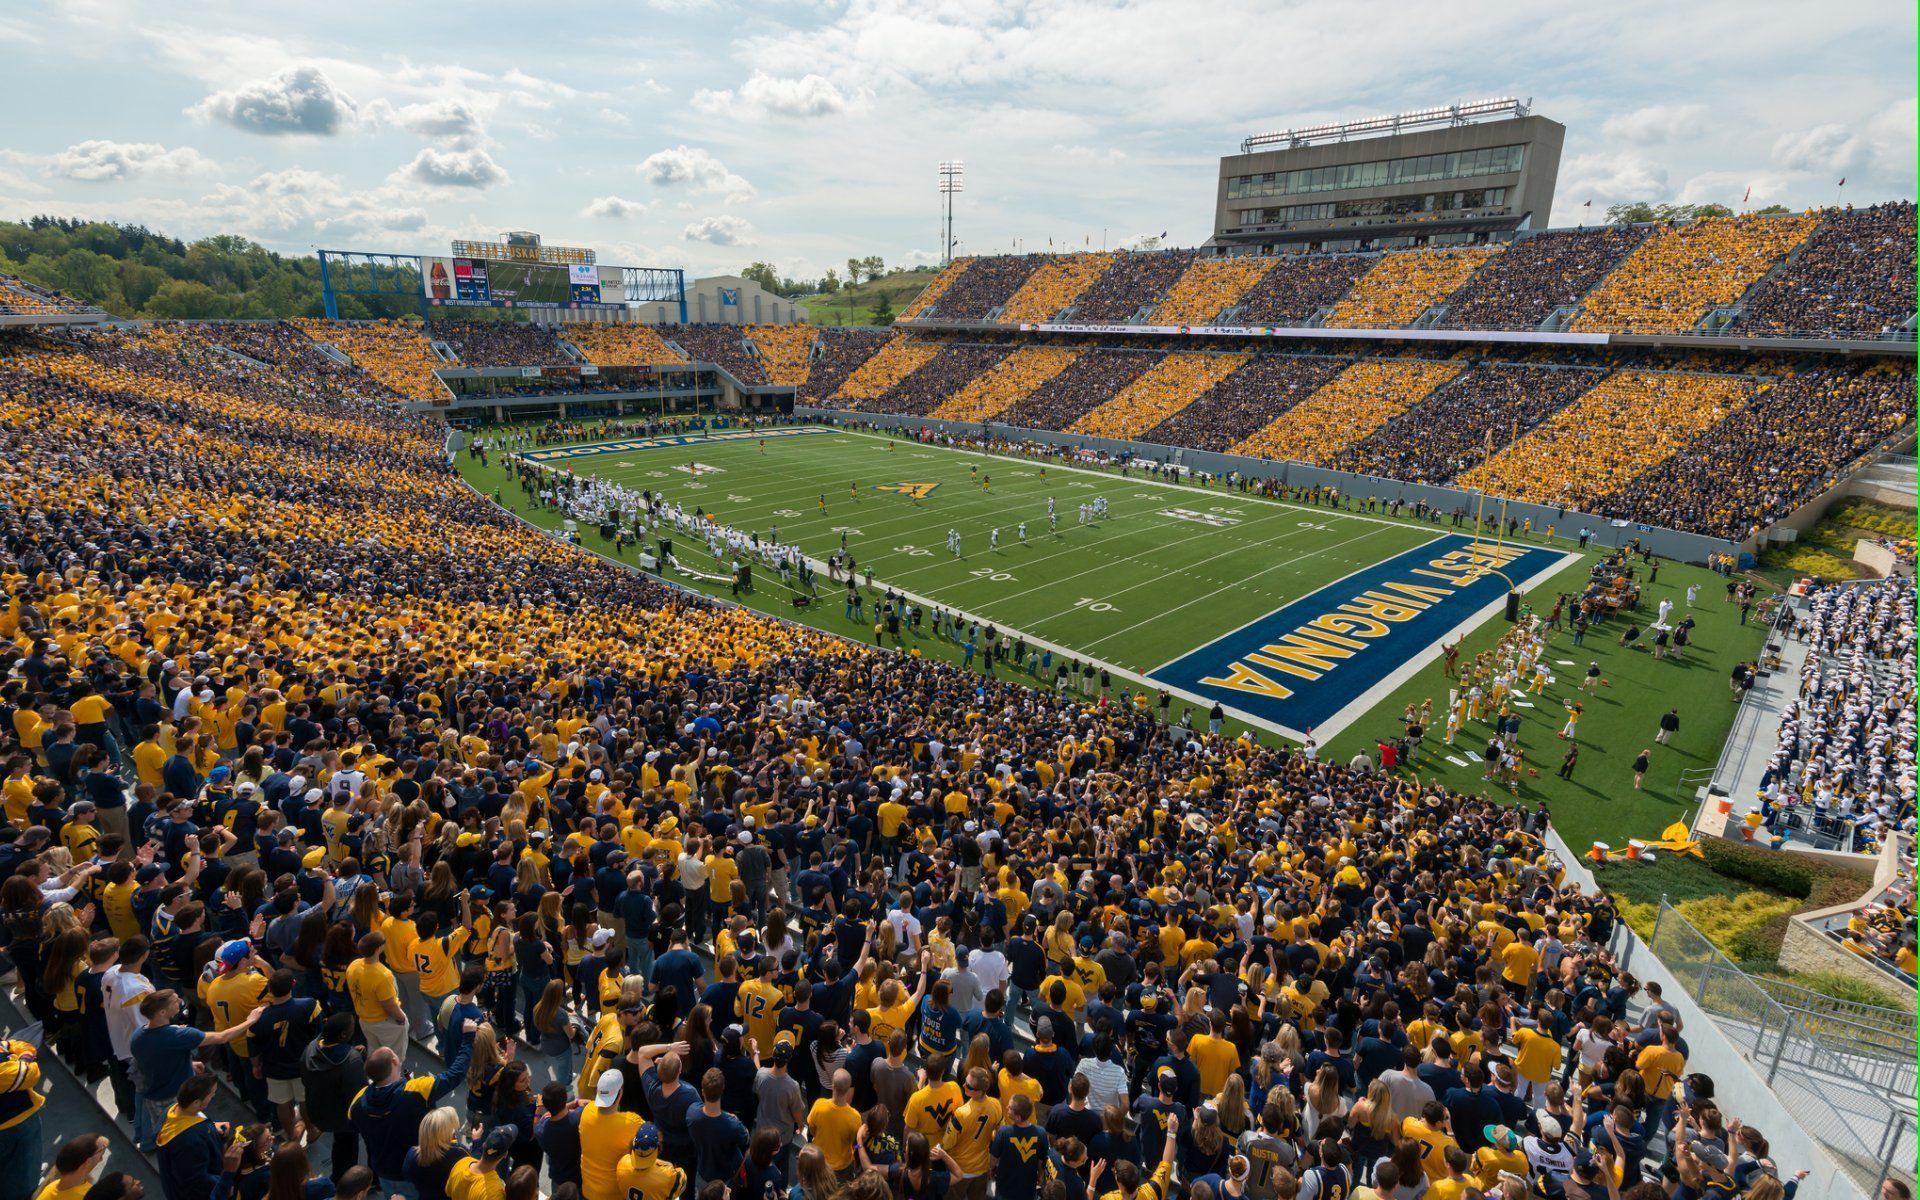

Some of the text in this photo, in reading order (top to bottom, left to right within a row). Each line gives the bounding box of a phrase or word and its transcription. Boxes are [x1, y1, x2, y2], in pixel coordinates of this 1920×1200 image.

[502, 246, 540, 259] PUSKAR
[893, 545, 930, 556] 30
[969, 567, 1013, 582] 20
[1073, 597, 1113, 612] 10
[1197, 542, 1532, 699] WEST VIRGINIA
[414, 953, 432, 974] 12
[744, 992, 766, 1020] 12
[1010, 1136, 1038, 1164] WV
[1252, 1148, 1278, 1162] AUSTIN
